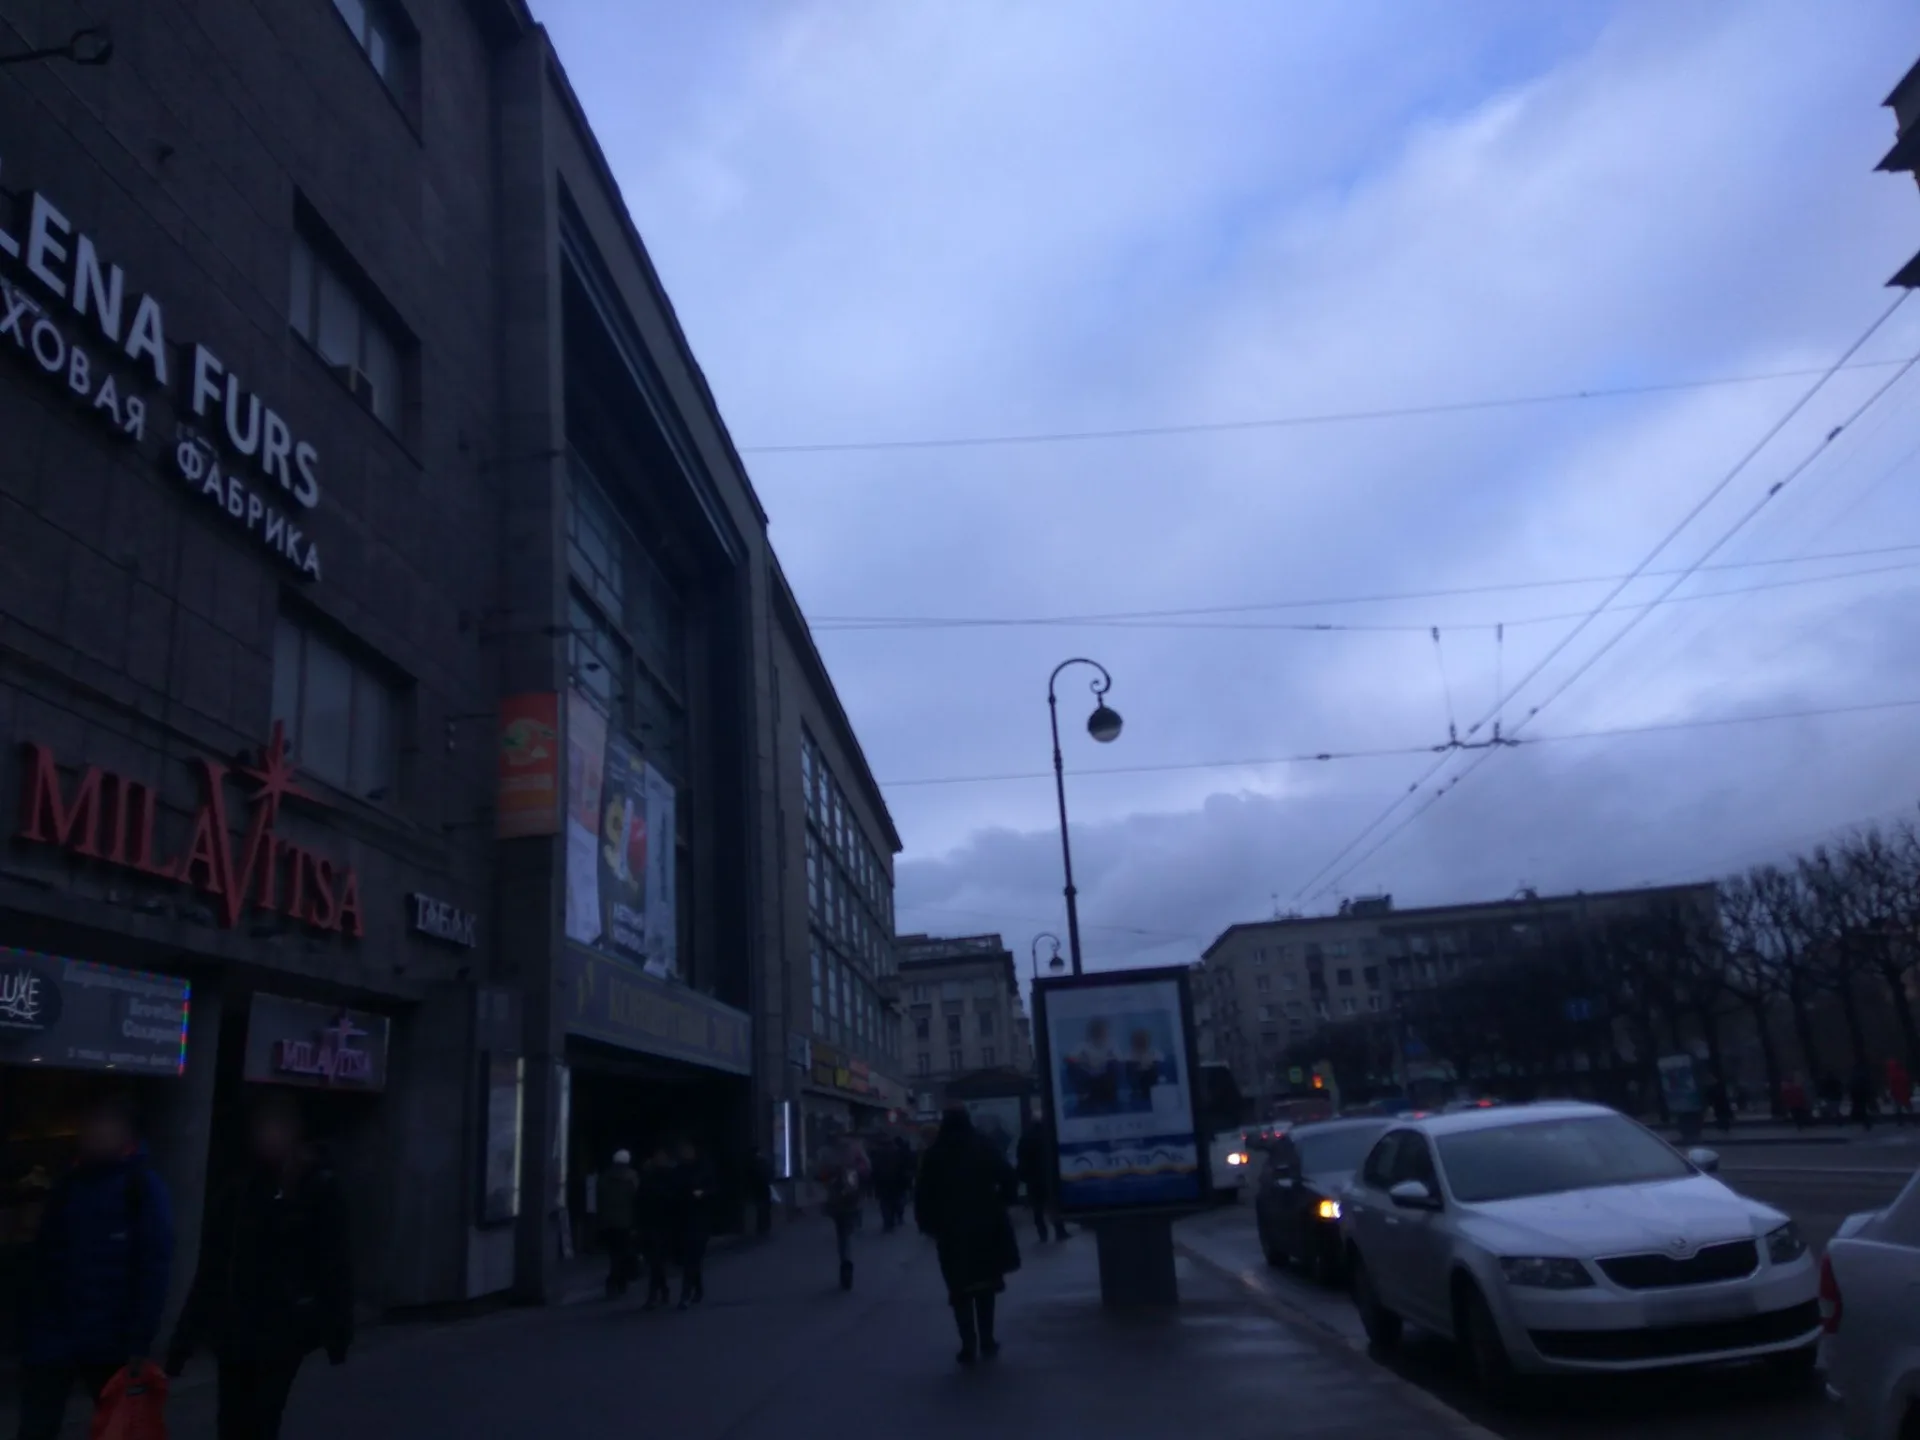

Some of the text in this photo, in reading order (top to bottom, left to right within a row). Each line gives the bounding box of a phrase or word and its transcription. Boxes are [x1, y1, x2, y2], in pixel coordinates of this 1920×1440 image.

[192, 342, 321, 509] FURS
[176, 440, 323, 582] ФАБРИКА
[19, 722, 365, 938] MILAVITSA
[413, 891, 478, 948] ТАБАК
